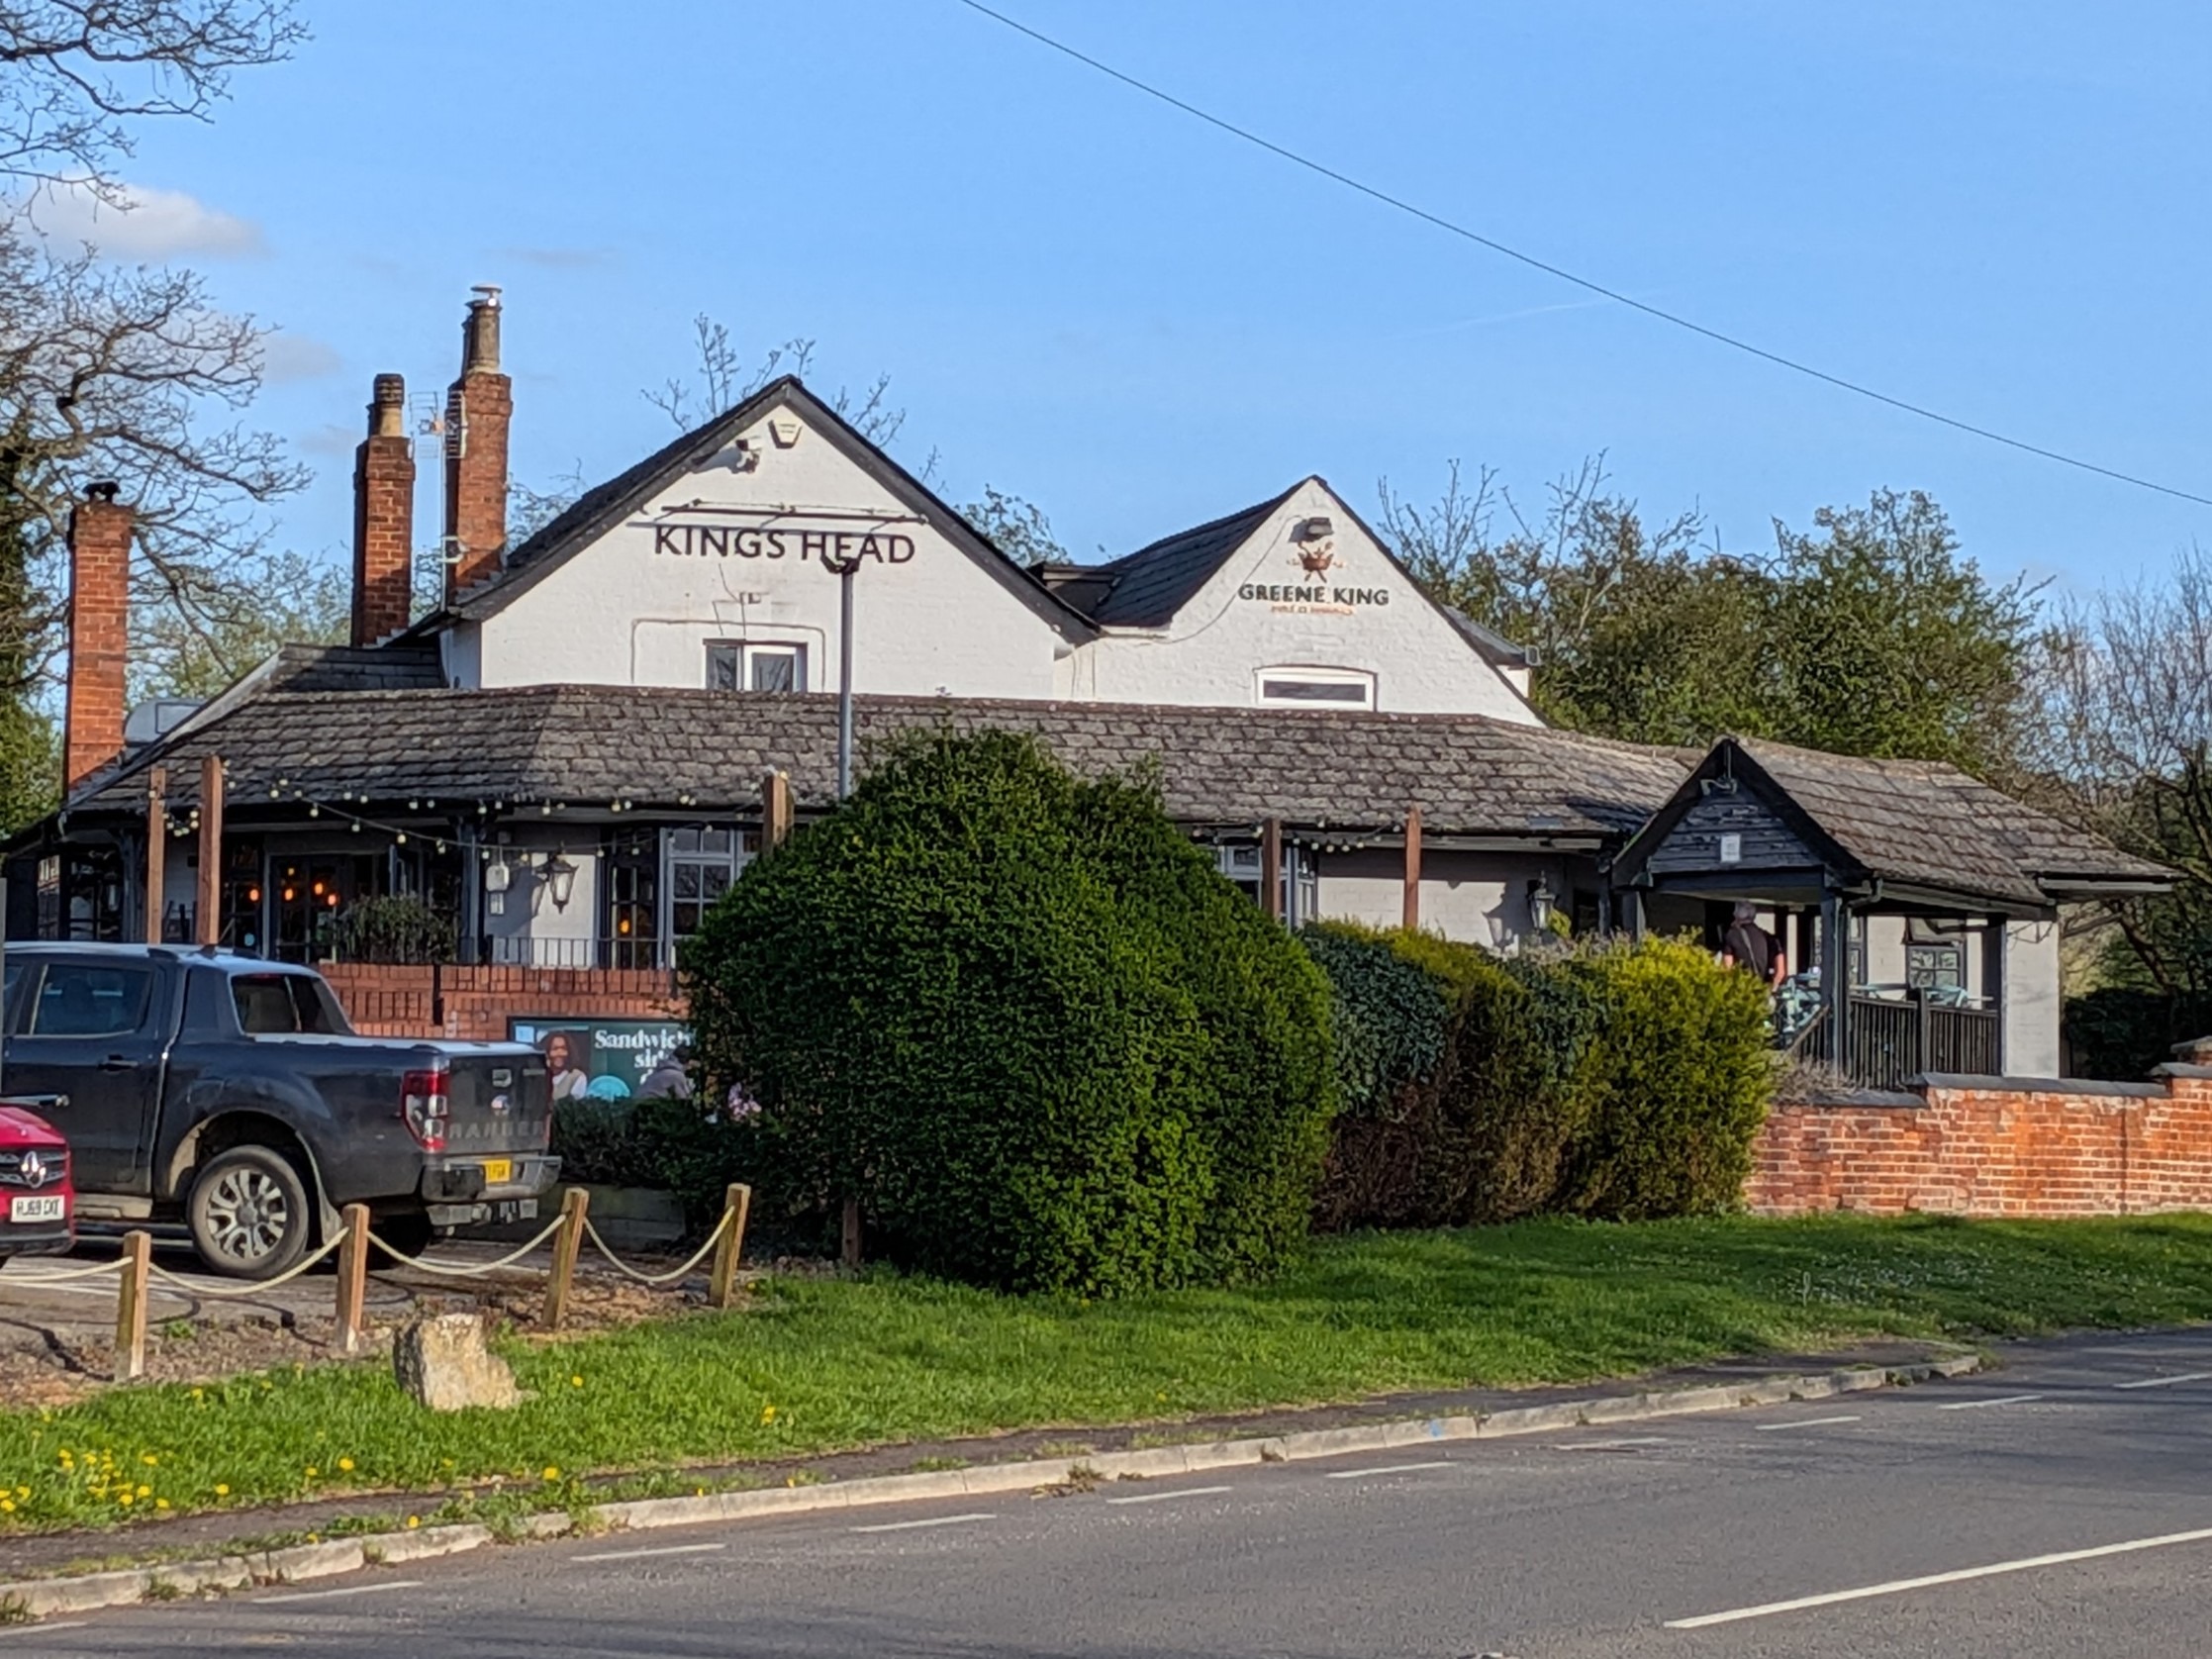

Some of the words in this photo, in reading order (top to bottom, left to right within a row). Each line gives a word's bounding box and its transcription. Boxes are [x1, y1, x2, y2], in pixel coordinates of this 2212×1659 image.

[654, 525, 786, 558] KINGS
[801, 531, 915, 563] HEAD
[1237, 583, 1326, 604] GREENE
[1332, 586, 1390, 606] KING
